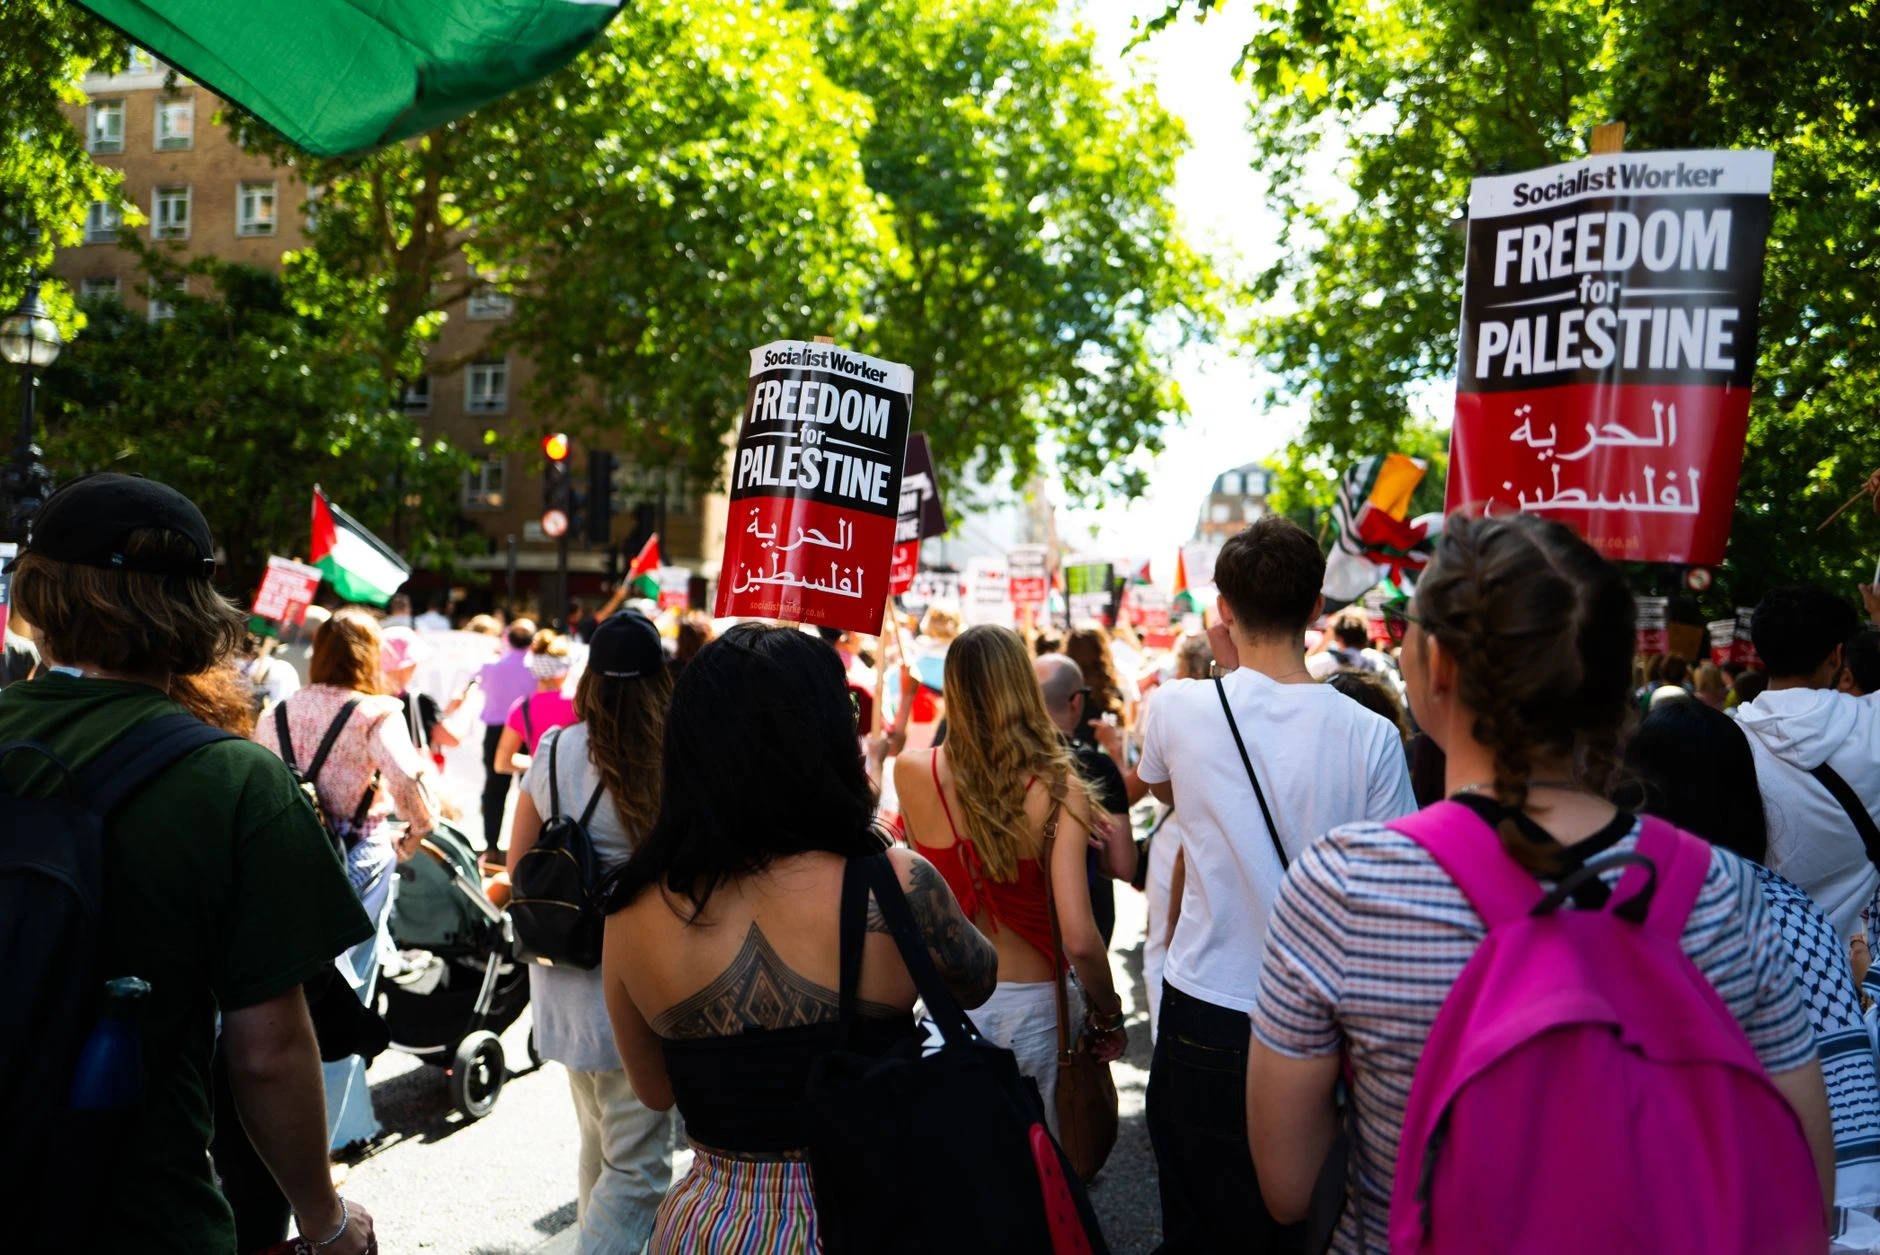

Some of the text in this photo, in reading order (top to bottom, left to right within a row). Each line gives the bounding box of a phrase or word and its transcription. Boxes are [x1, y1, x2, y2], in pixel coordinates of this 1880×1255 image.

[1513, 163, 1724, 207] Socialist Worker
[1494, 209, 1732, 287] FREEDOM
[1579, 274, 1620, 304] for
[764, 347, 887, 383] Socialist Worker
[1475, 307, 1739, 378] PALESTINE
[750, 380, 890, 439] FREEDOM
[1510, 400, 1677, 460] الحرية
[800, 424, 825, 445] for
[737, 445, 891, 506] PALESTINE
[747, 507, 853, 551] الحرية
[732, 552, 864, 598] لفلسطين
[750, 601, 826, 618] socialistorker.co.uk
